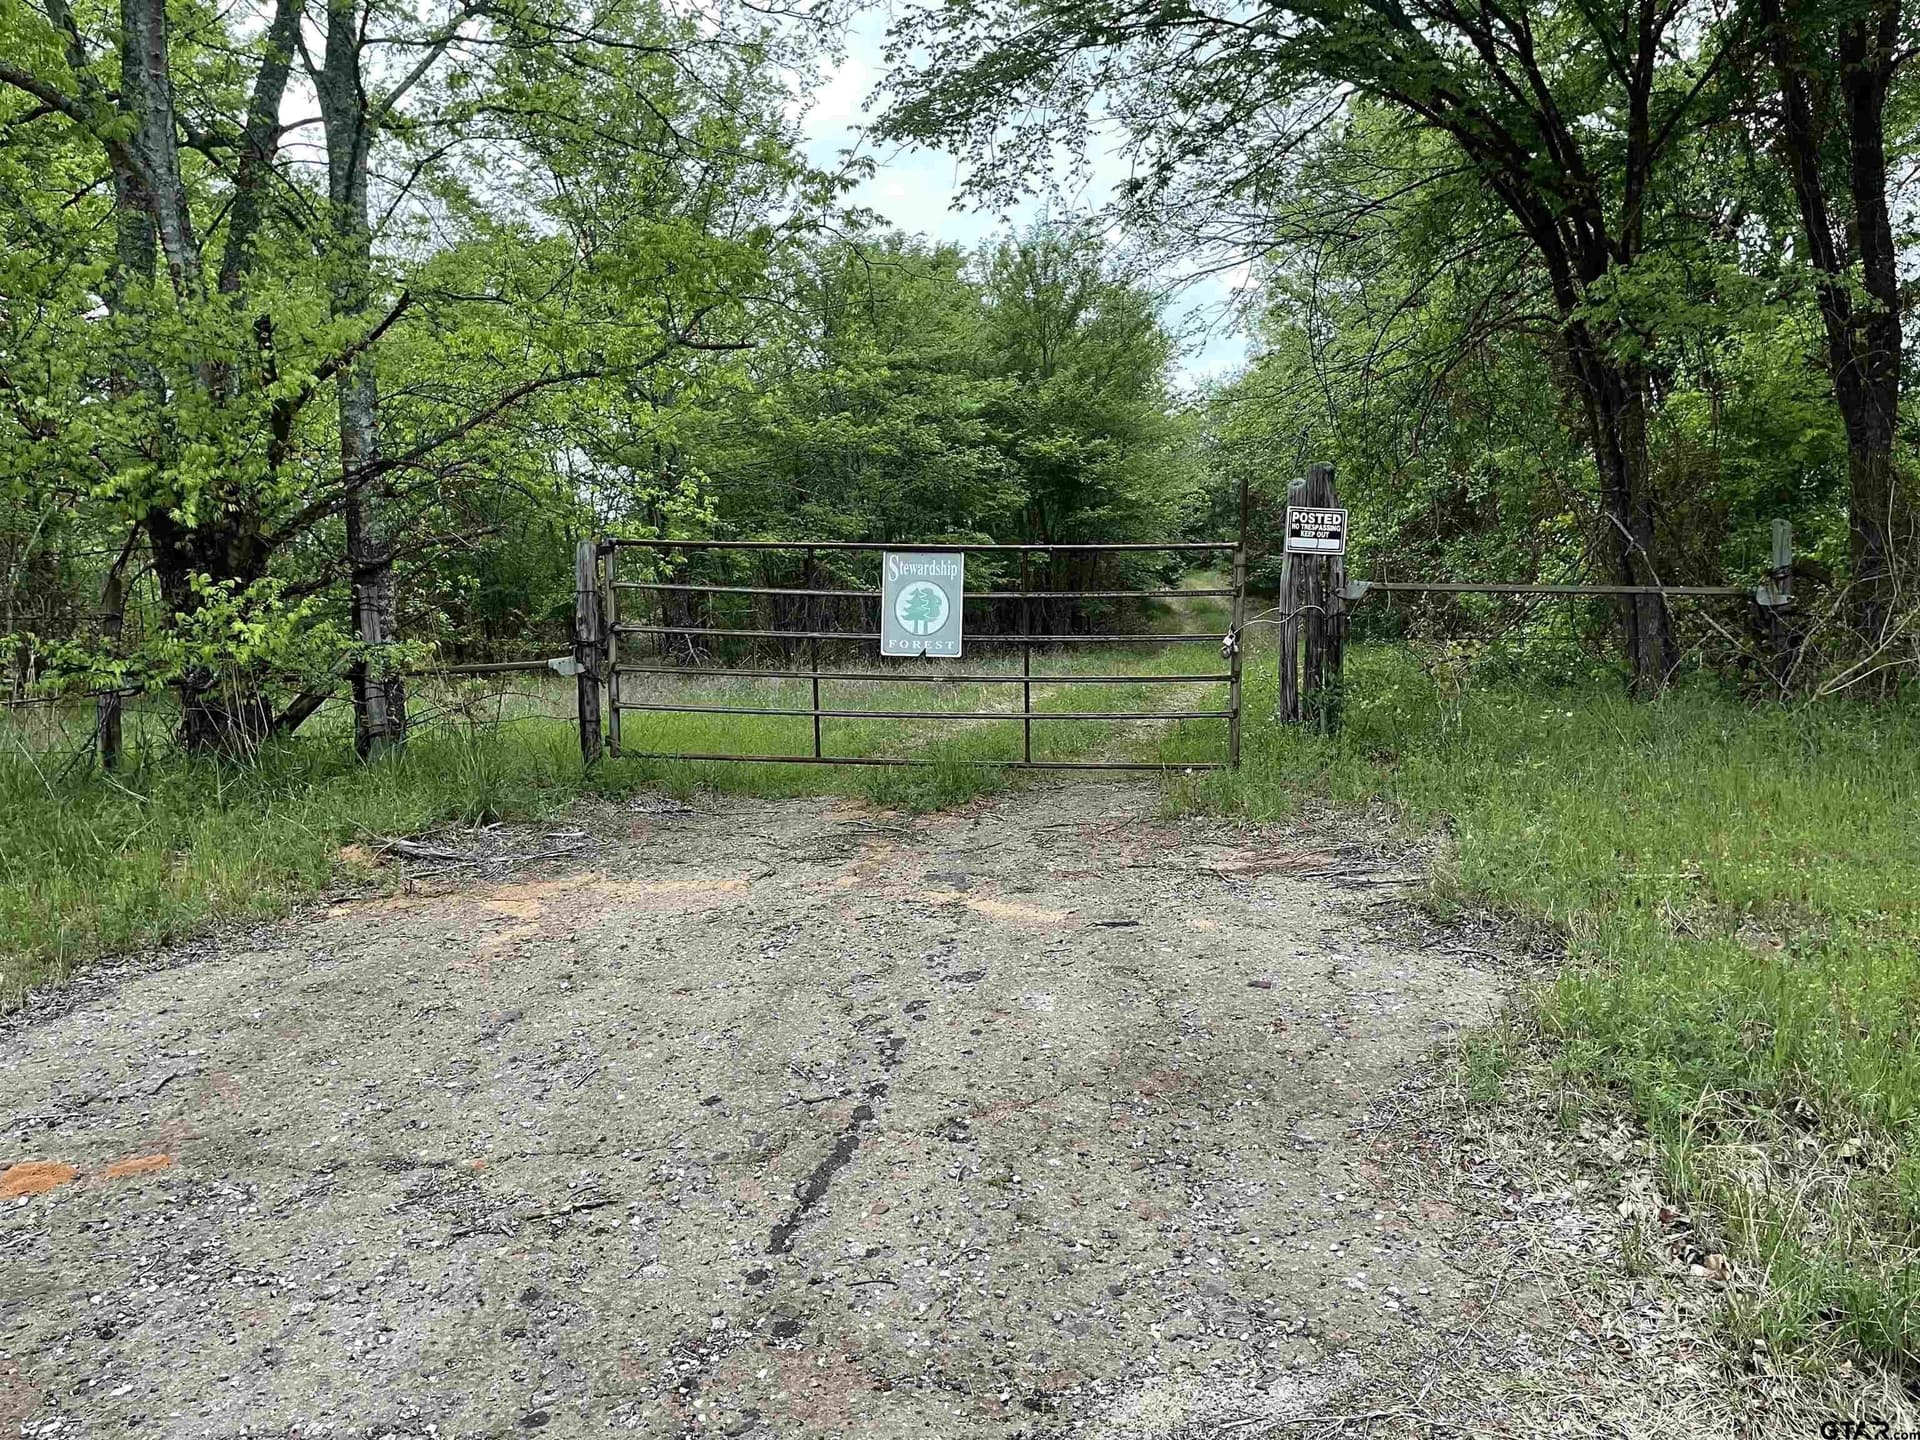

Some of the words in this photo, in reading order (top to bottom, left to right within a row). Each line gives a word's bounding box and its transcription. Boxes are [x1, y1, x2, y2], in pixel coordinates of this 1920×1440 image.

[1292, 512, 1342, 525] POSTED
[1301, 524, 1341, 532] TRESPASSING
[1301, 530, 1316, 538] KEEP
[888, 554, 958, 582] Stewardship
[888, 639, 955, 650] FOREST
